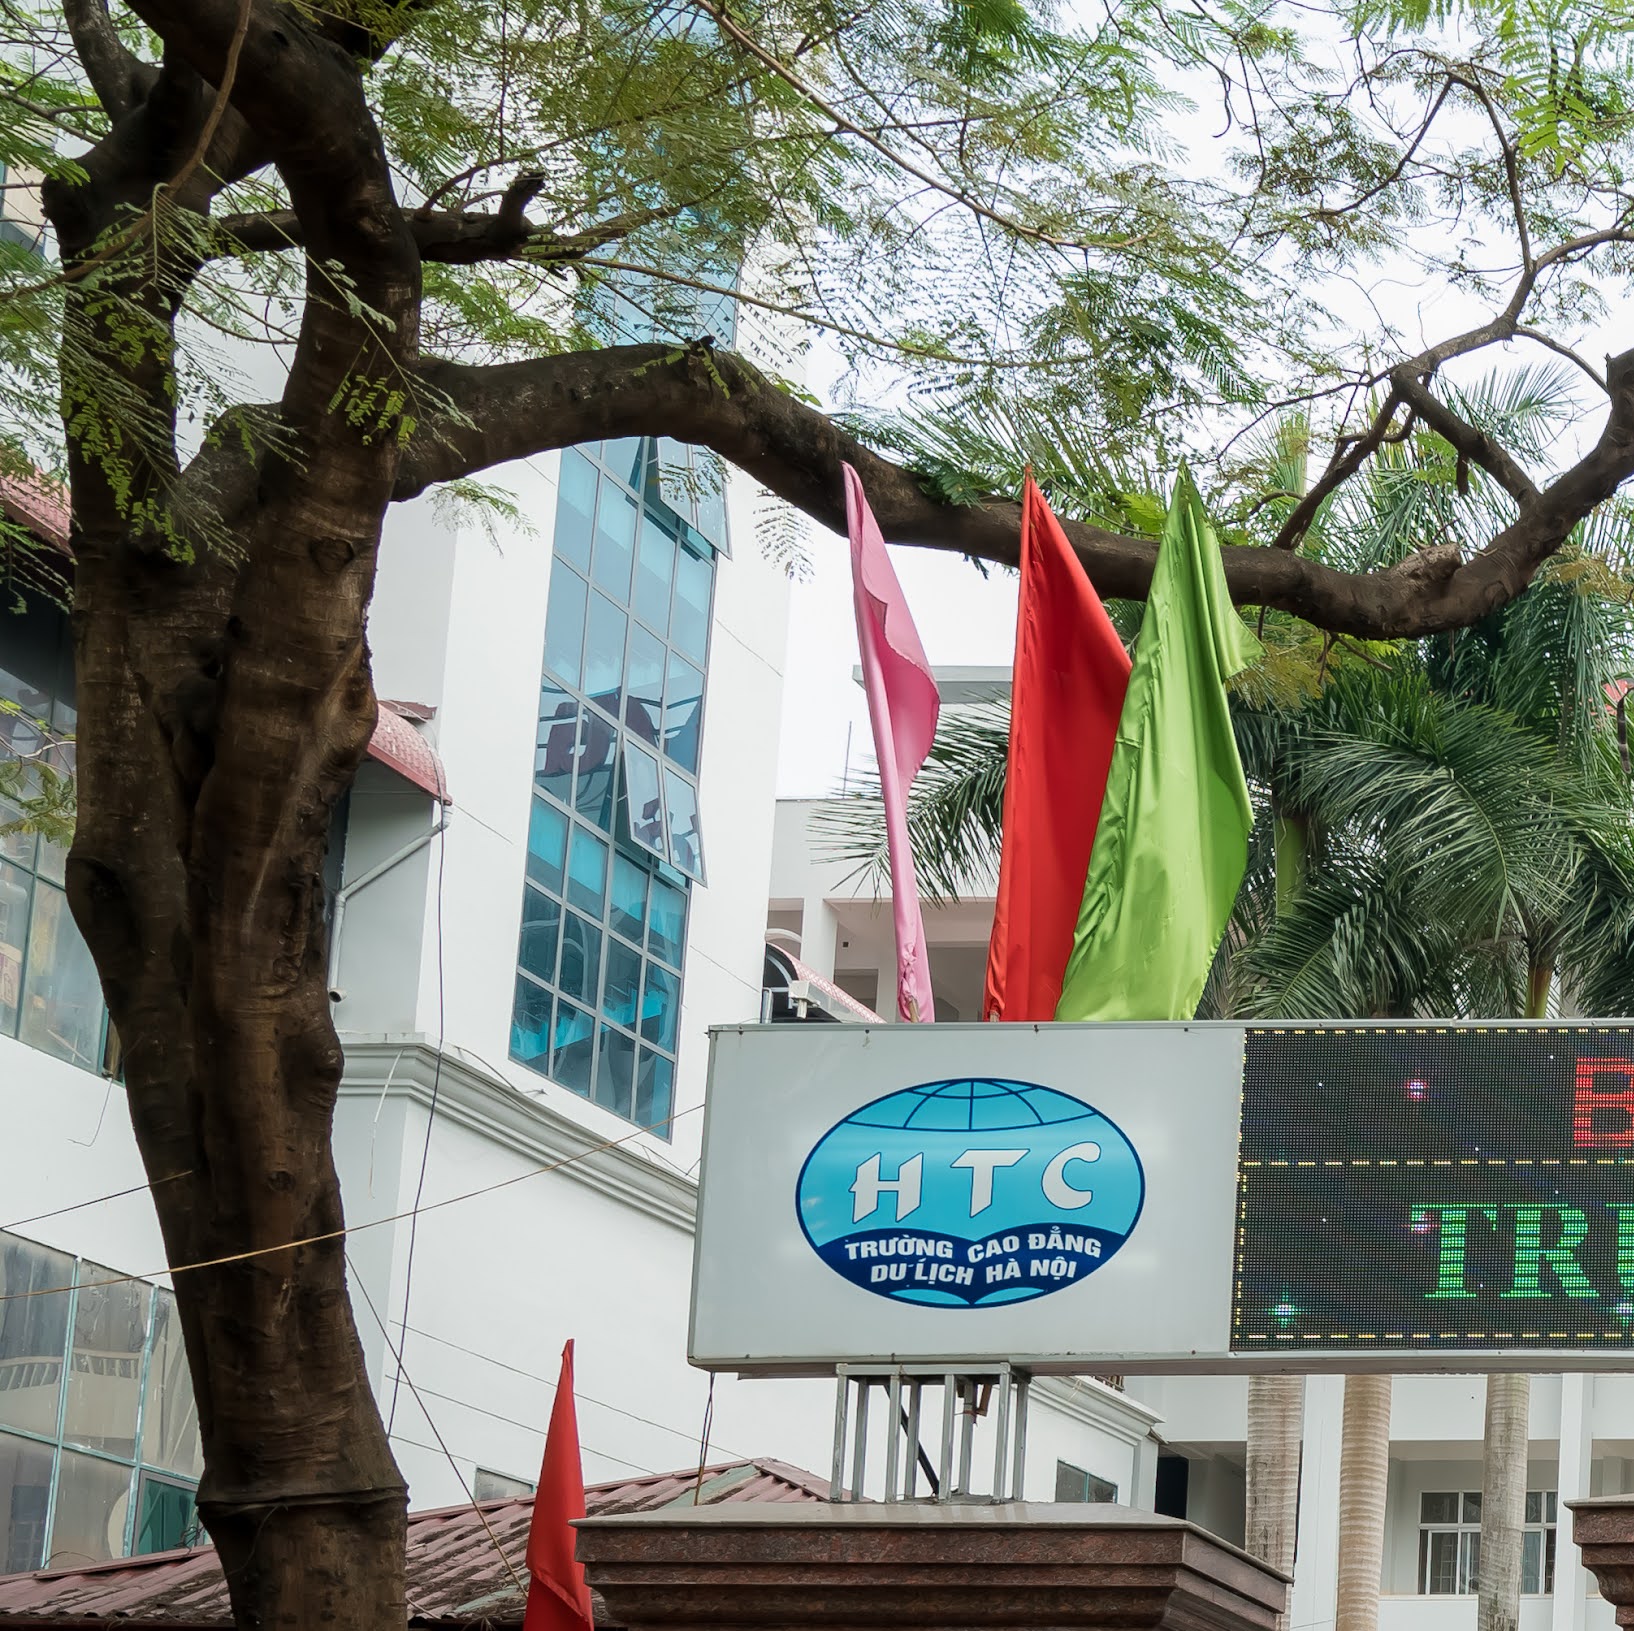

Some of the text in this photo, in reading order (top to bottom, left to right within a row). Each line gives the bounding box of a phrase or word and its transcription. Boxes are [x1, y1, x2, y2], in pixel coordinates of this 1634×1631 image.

[848, 1140, 1101, 1224] HTC
[844, 1225, 1101, 1264] TRƯỜNG CAO ĐẲNG
[870, 1254, 1077, 1286] DU LỊCH HÀ NỘI
